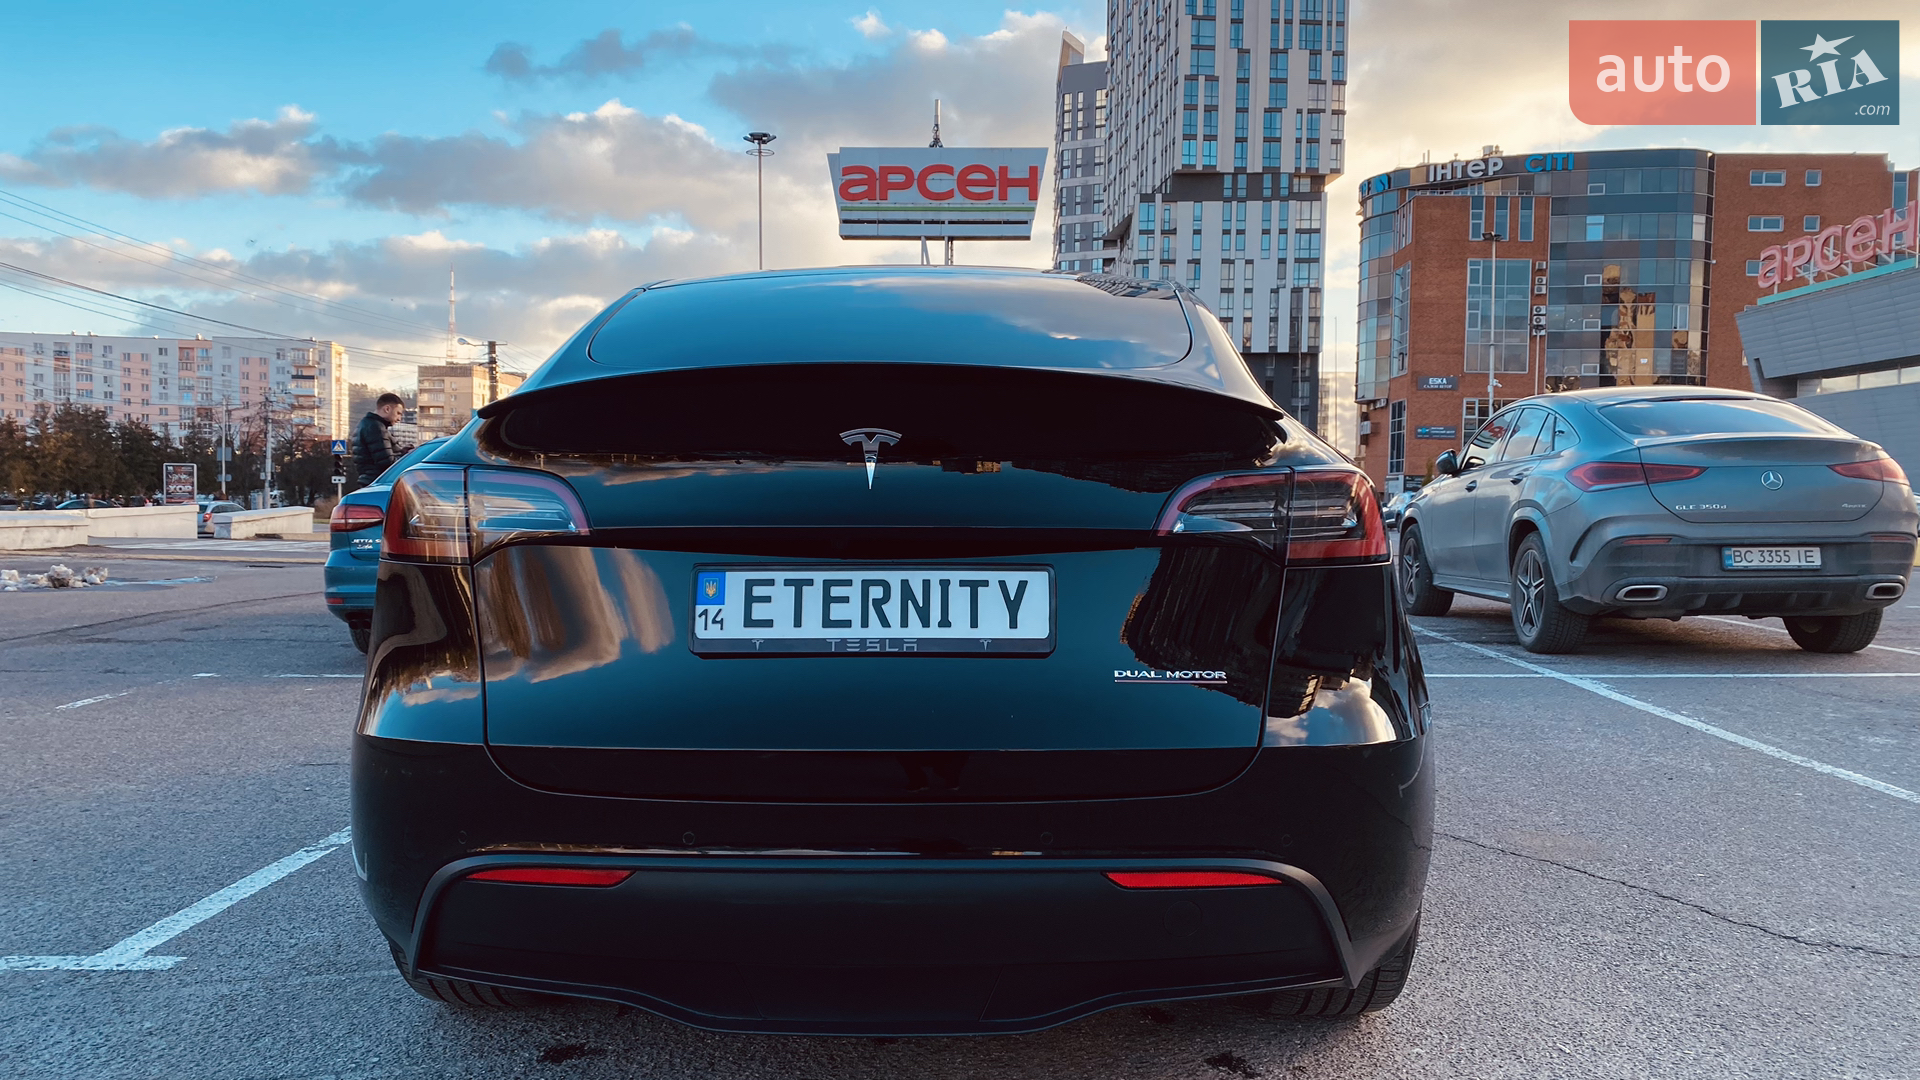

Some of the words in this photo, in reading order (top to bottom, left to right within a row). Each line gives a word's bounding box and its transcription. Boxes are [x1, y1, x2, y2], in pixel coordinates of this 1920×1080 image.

[1757, 549, 1791, 564] 3355
[1797, 549, 1815, 564] IE
[742, 578, 1029, 630] ETERNITY
[697, 608, 725, 632] 14
[825, 638, 918, 653] TESLA
[1114, 670, 1162, 678] DUAL
[1166, 670, 1227, 679] MOTOR
